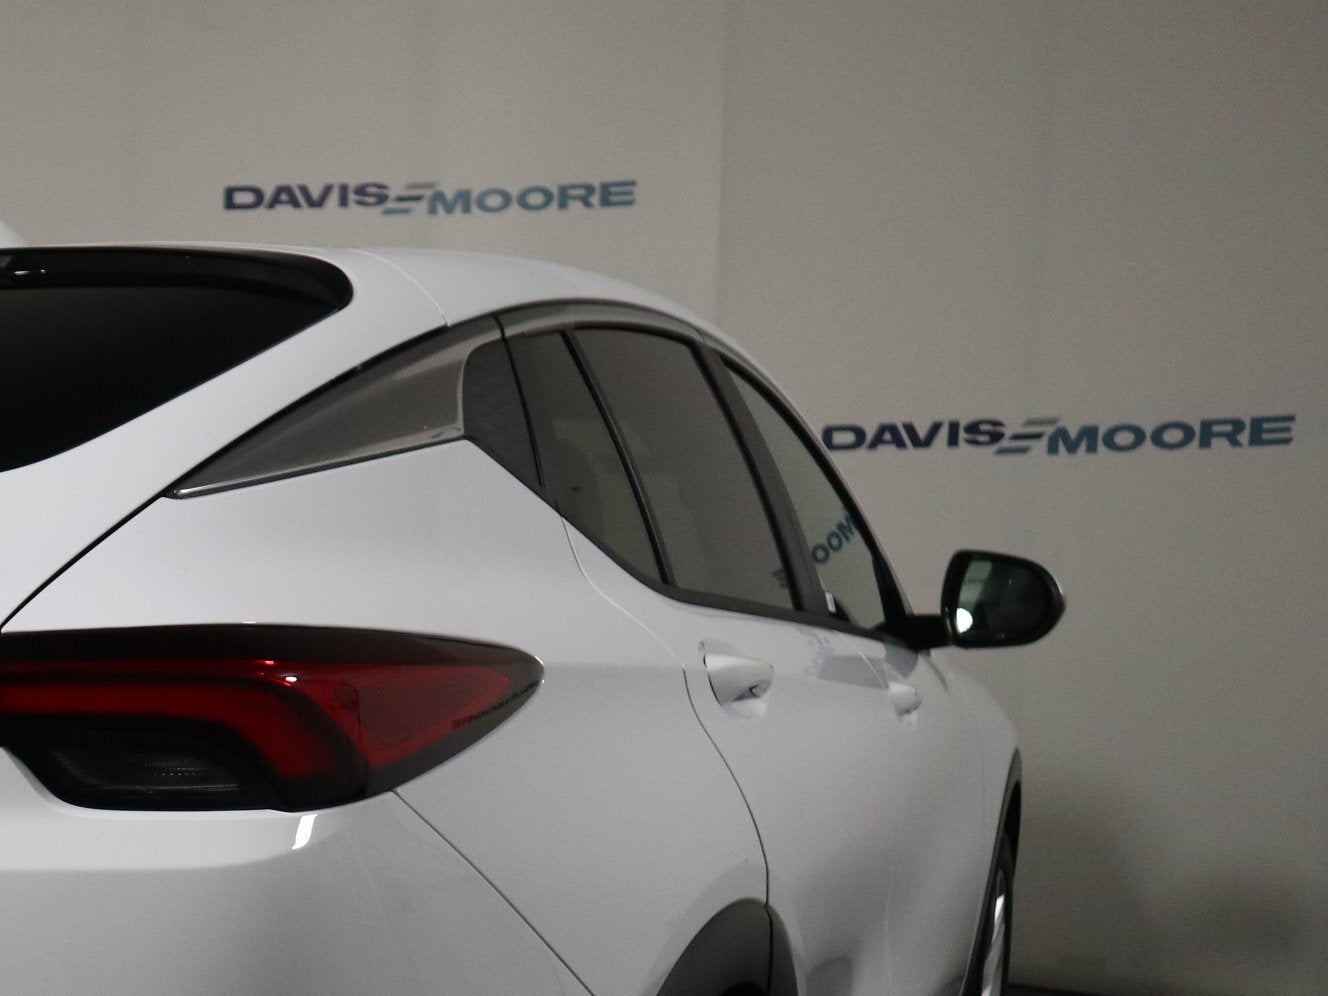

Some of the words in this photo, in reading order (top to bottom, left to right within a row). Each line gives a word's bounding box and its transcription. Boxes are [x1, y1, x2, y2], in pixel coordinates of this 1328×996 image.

[224, 182, 391, 211] DAVIS
[427, 180, 638, 216] MOORE
[822, 419, 1007, 452] DAVIS
[1046, 414, 1297, 455] MOORE
